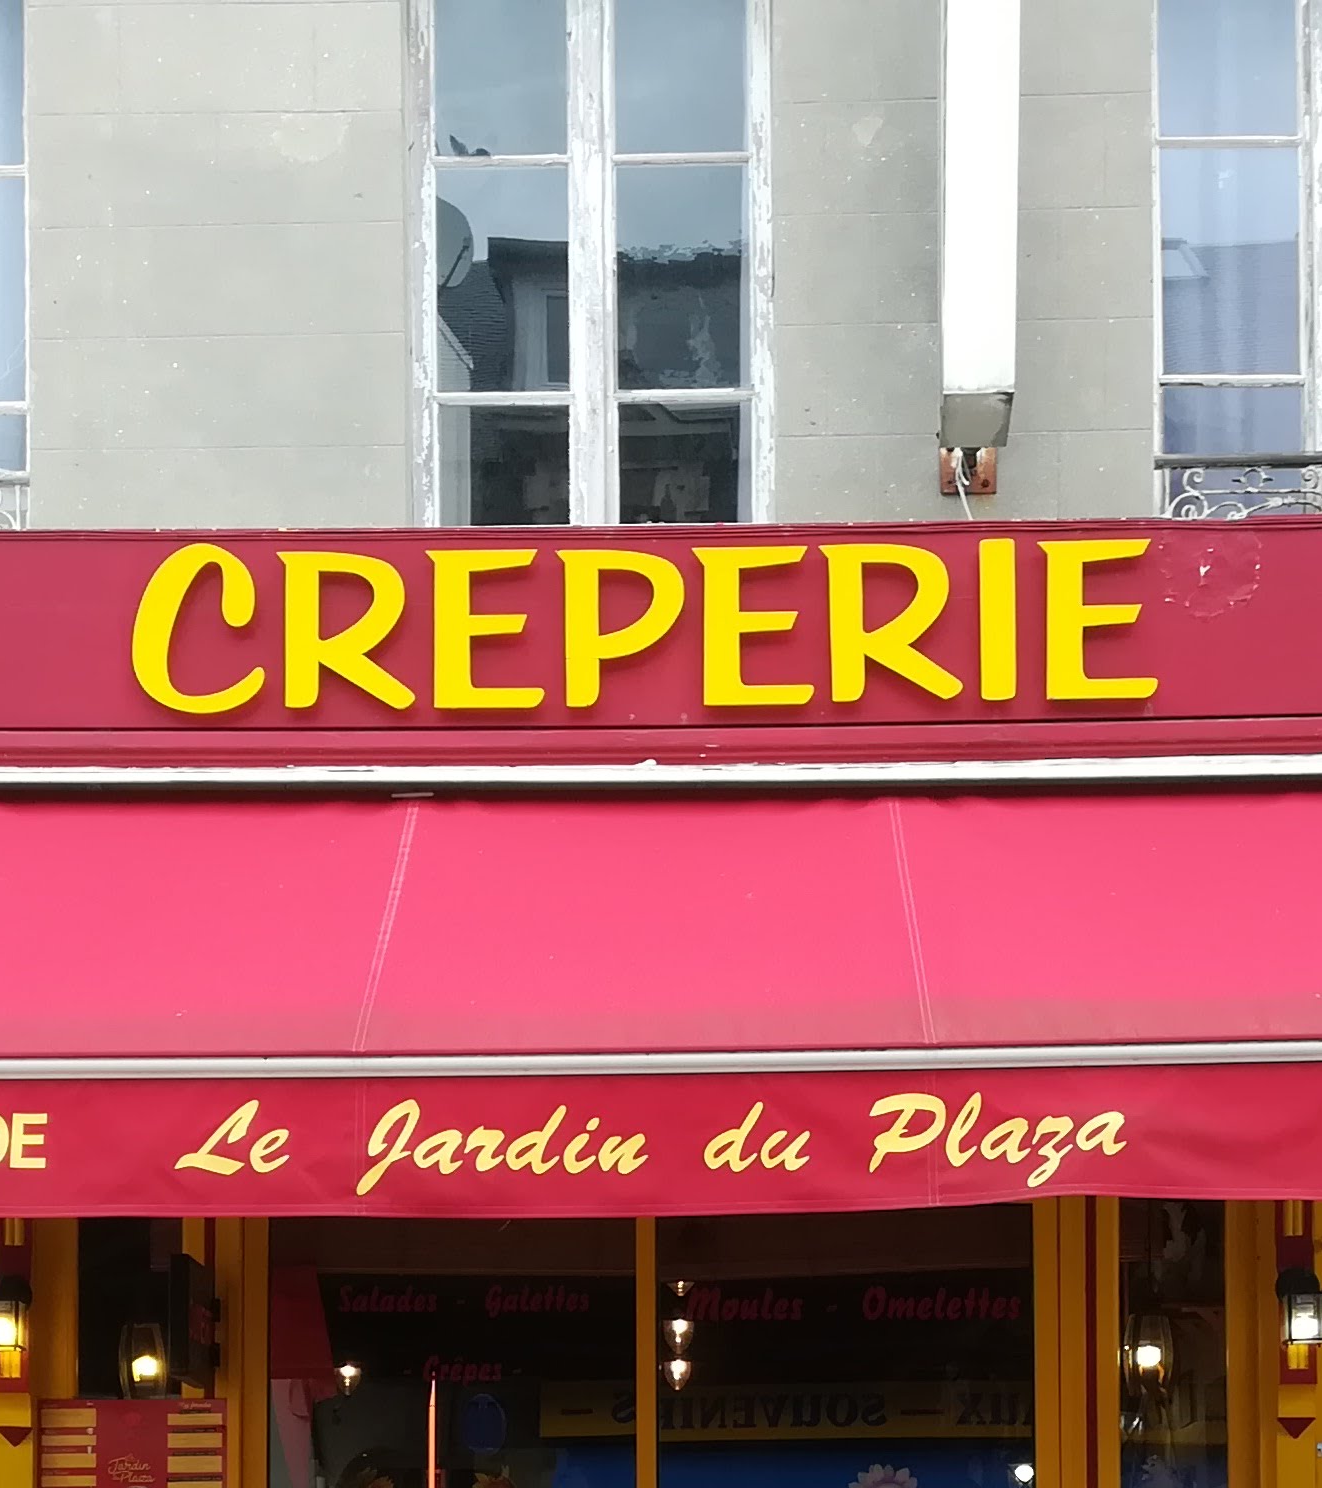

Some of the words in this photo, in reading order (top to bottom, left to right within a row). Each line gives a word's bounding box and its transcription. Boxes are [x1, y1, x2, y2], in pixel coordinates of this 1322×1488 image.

[131, 537, 1159, 714] CREPERIE
[174, 1099, 291, 1176] Le
[355, 1099, 650, 1196] Jardin
[702, 1100, 811, 1172] du
[867, 1091, 1127, 1188] Plaza
[338, 1286, 439, 1314] Salades
[485, 1286, 591, 1316] Galettes
[687, 1288, 804, 1322] Moules
[862, 1286, 1024, 1322] Omelettes
[422, 1354, 503, 1387] Crêpes
